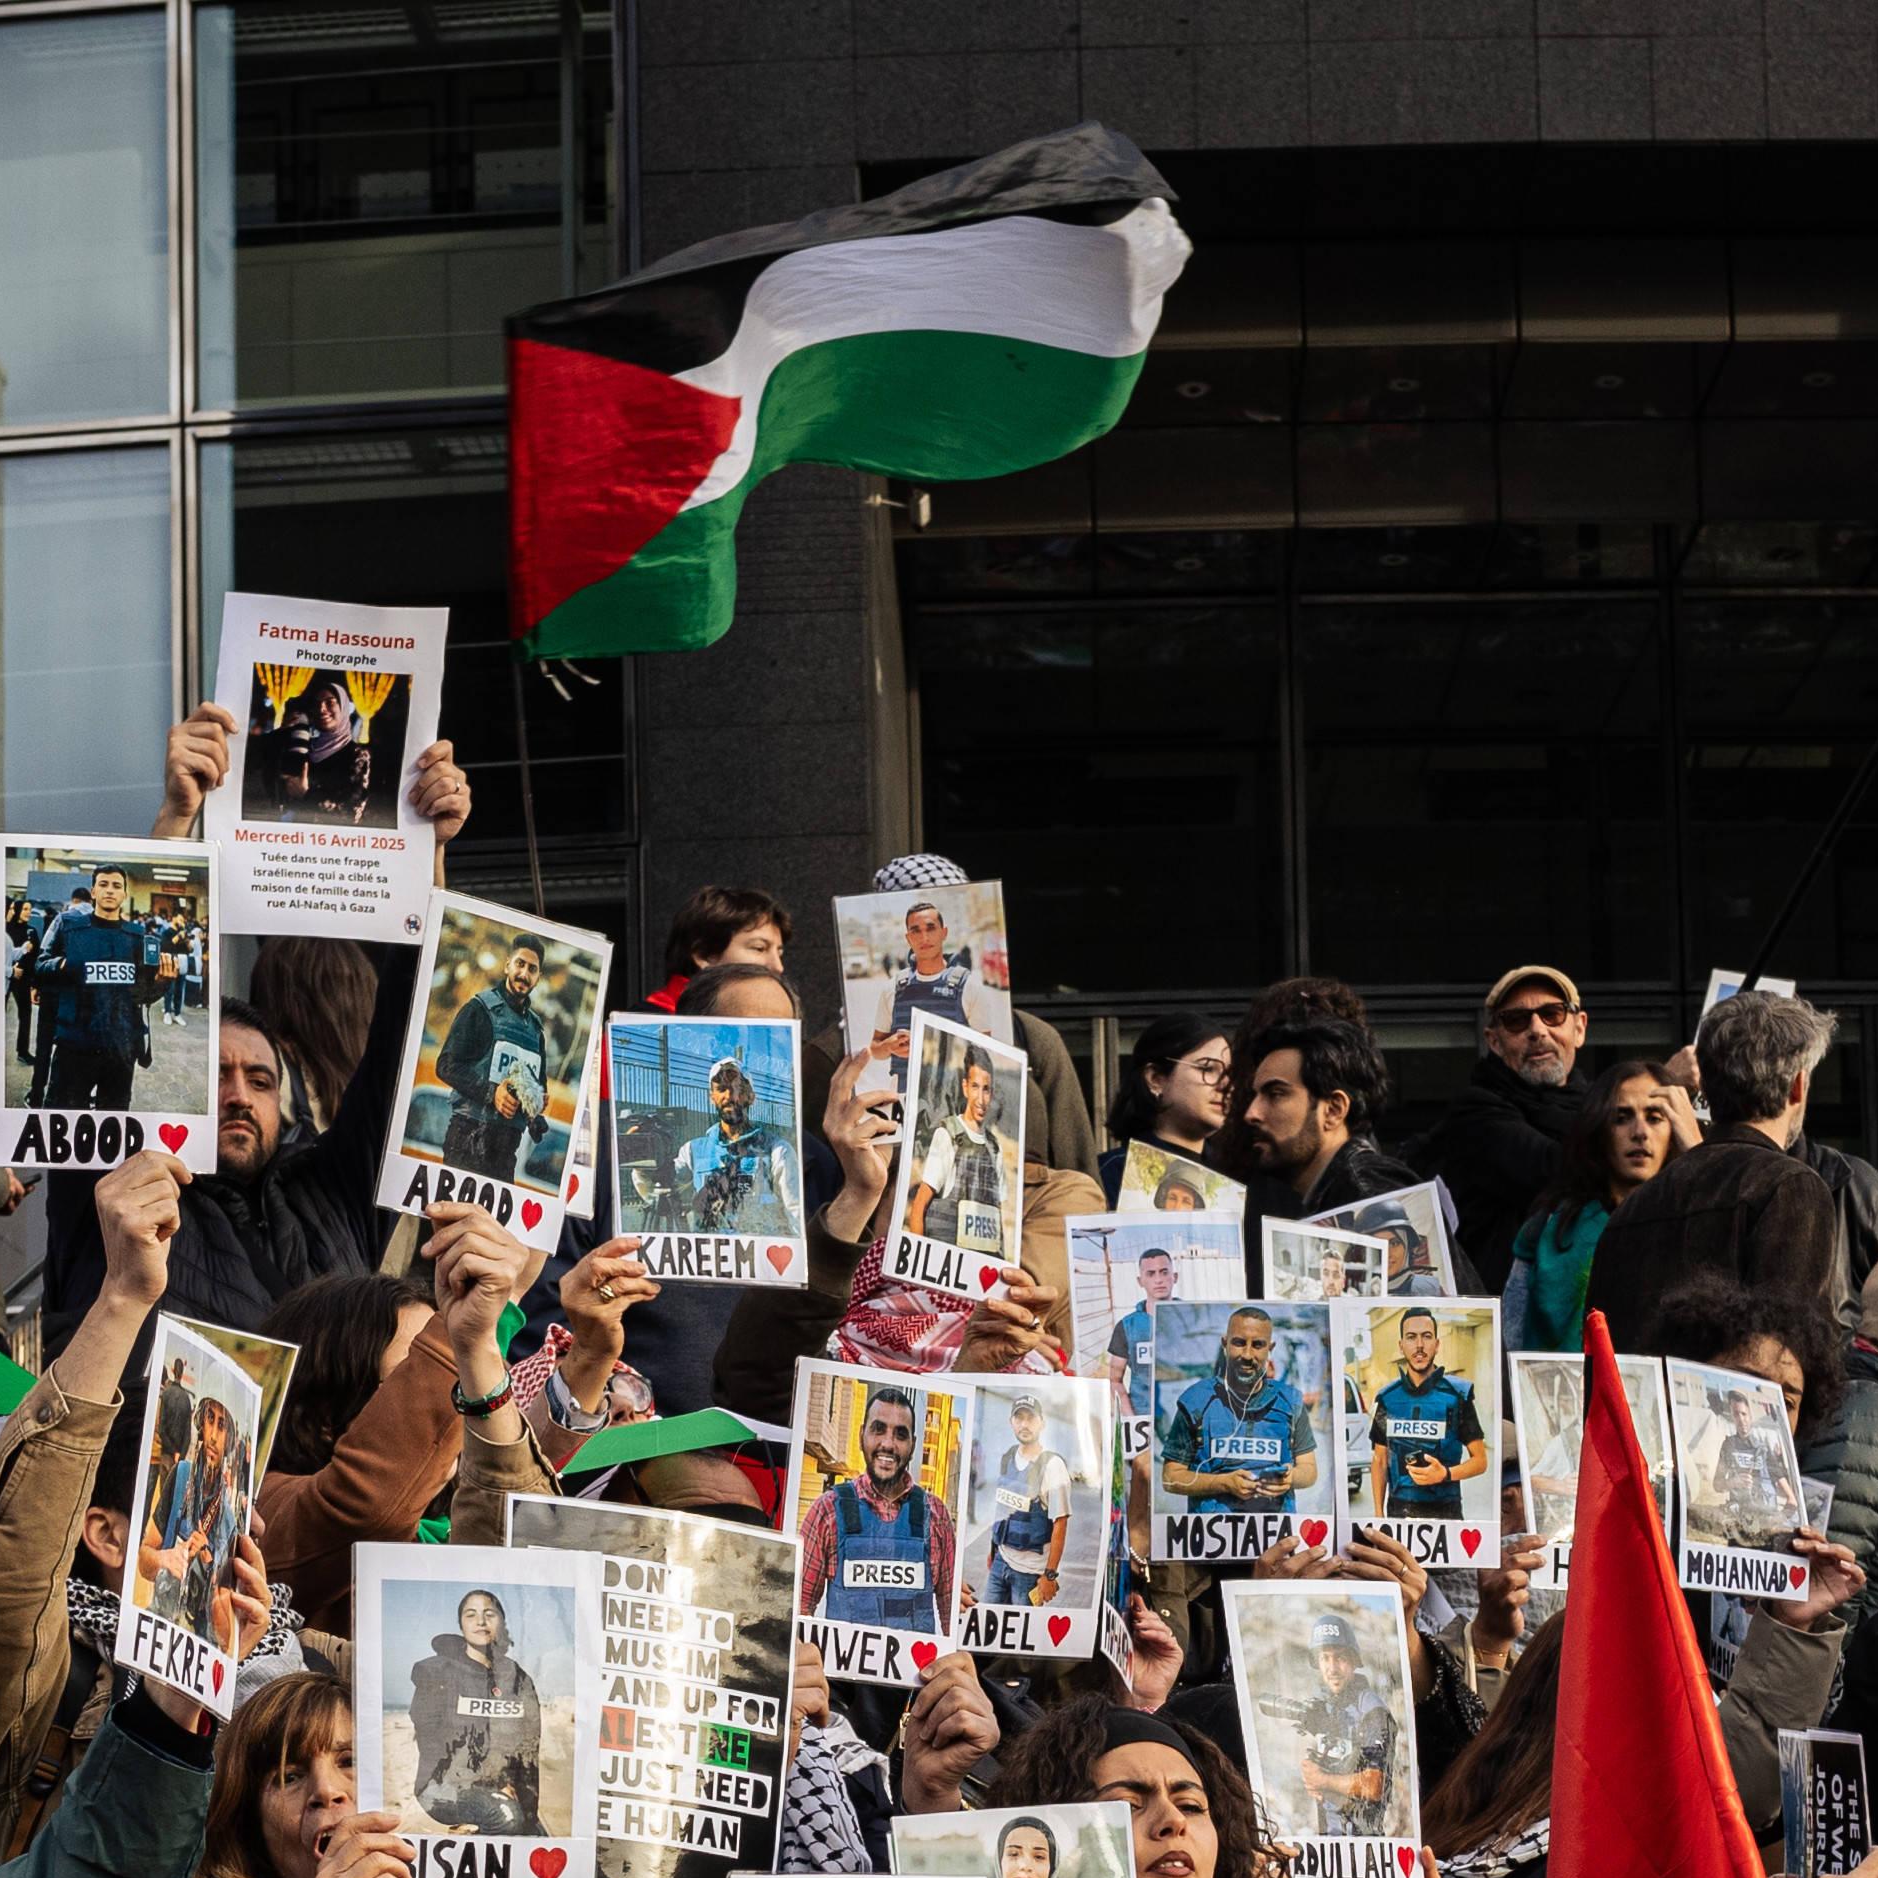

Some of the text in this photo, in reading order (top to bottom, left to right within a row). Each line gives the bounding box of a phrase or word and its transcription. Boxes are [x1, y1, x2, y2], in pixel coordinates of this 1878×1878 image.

[258, 622, 416, 651] Fatma Hassouna
[296, 648, 377, 667] Photographe
[235, 829, 406, 850] Mercredi 16 Avril 2025
[253, 866, 388, 884] israélienne qui a ciblé sa
[261, 851, 380, 870] Tuée dans une frappe
[251, 882, 390, 899] maison de famille dans la
[267, 898, 376, 914] rue Al-Nafaq à Gaza
[85, 963, 135, 983] PRESS
[12, 1113, 144, 1164] ABOOD
[964, 1214, 999, 1239] PRESS
[638, 1236, 756, 1279] KAREEM
[894, 1241, 969, 1291] BILAL
[1393, 1421, 1438, 1437] PRESS
[1215, 1439, 1279, 1456] PRESS
[1167, 1514, 1293, 1559] MOSTAFA
[852, 1564, 914, 1585] PRESS
[1687, 1549, 1788, 1593] MOHANNAD
[698, 1614, 732, 1644] TO
[959, 1611, 1035, 1651] ADEL
[134, 1613, 205, 1695] FEKRE
[470, 1700, 522, 1715] PRESS
[684, 1686, 776, 1729] UP FOR
[602, 1762, 770, 1812] JUST NEED
[1831, 1774, 1843, 1818] OF
[1847, 1779, 1860, 1840] THE
[625, 1805, 739, 1853] HUMAN
